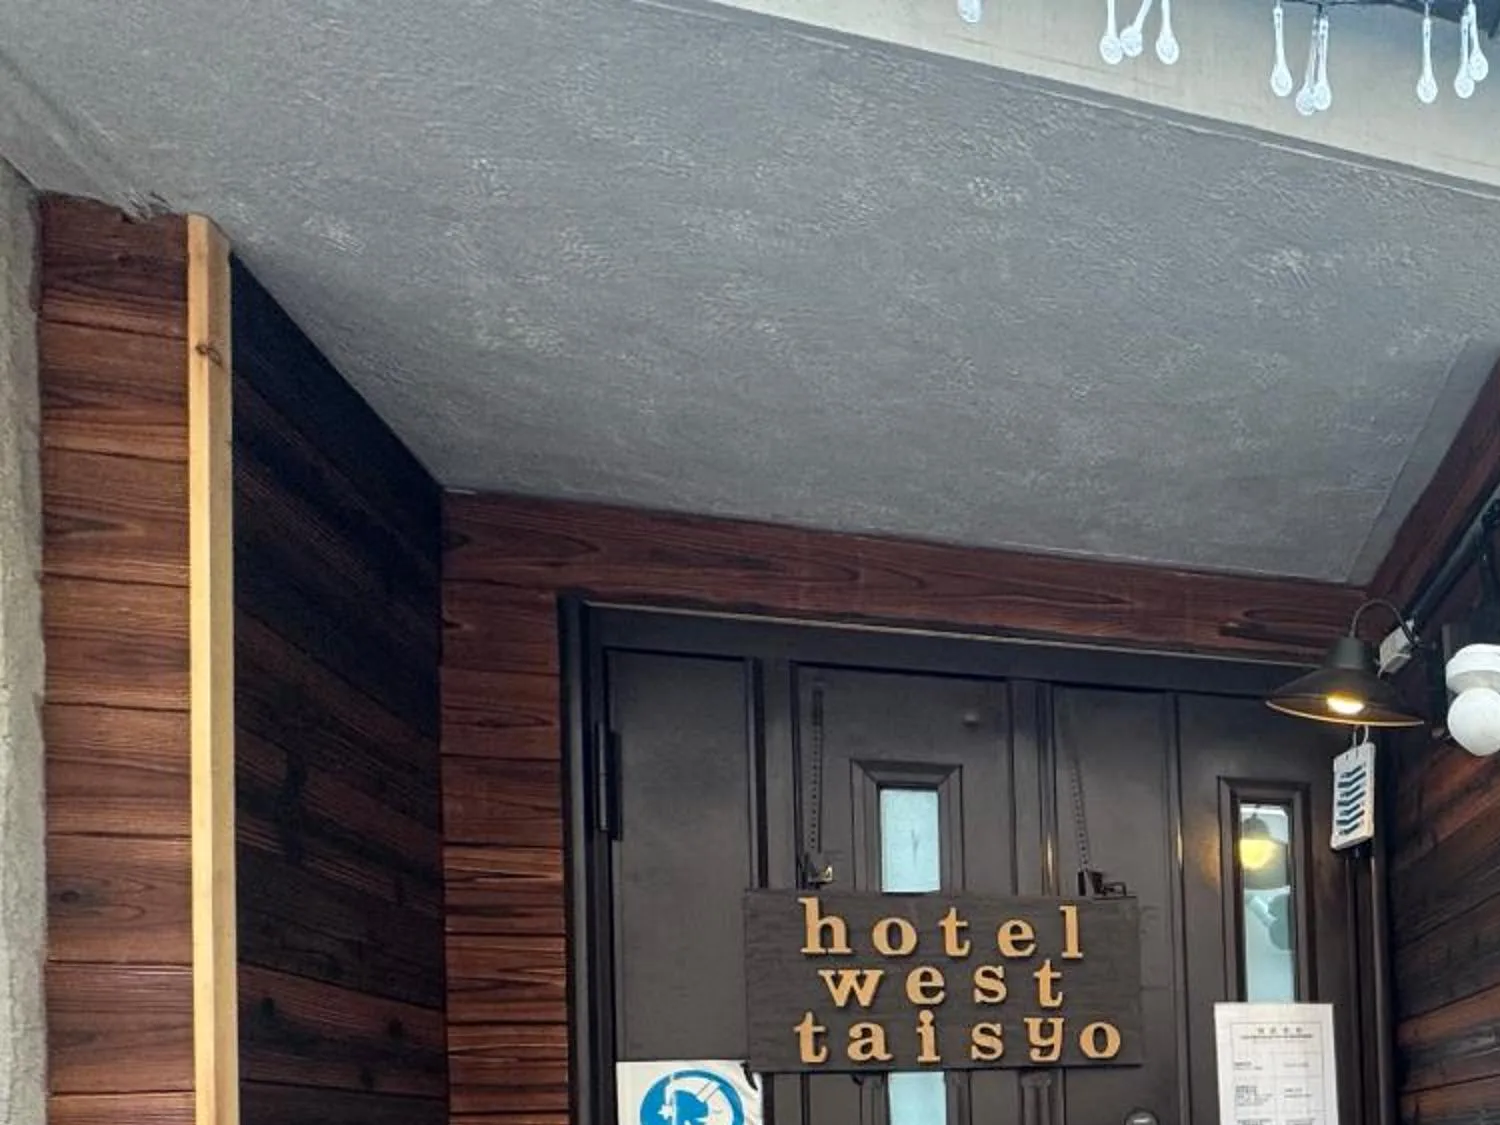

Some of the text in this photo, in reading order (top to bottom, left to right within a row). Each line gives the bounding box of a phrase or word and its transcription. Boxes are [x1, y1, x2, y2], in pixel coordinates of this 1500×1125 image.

[799, 897, 1083, 959] hotel
[818, 958, 1064, 1008] west
[794, 1010, 1122, 1064] taisyo
